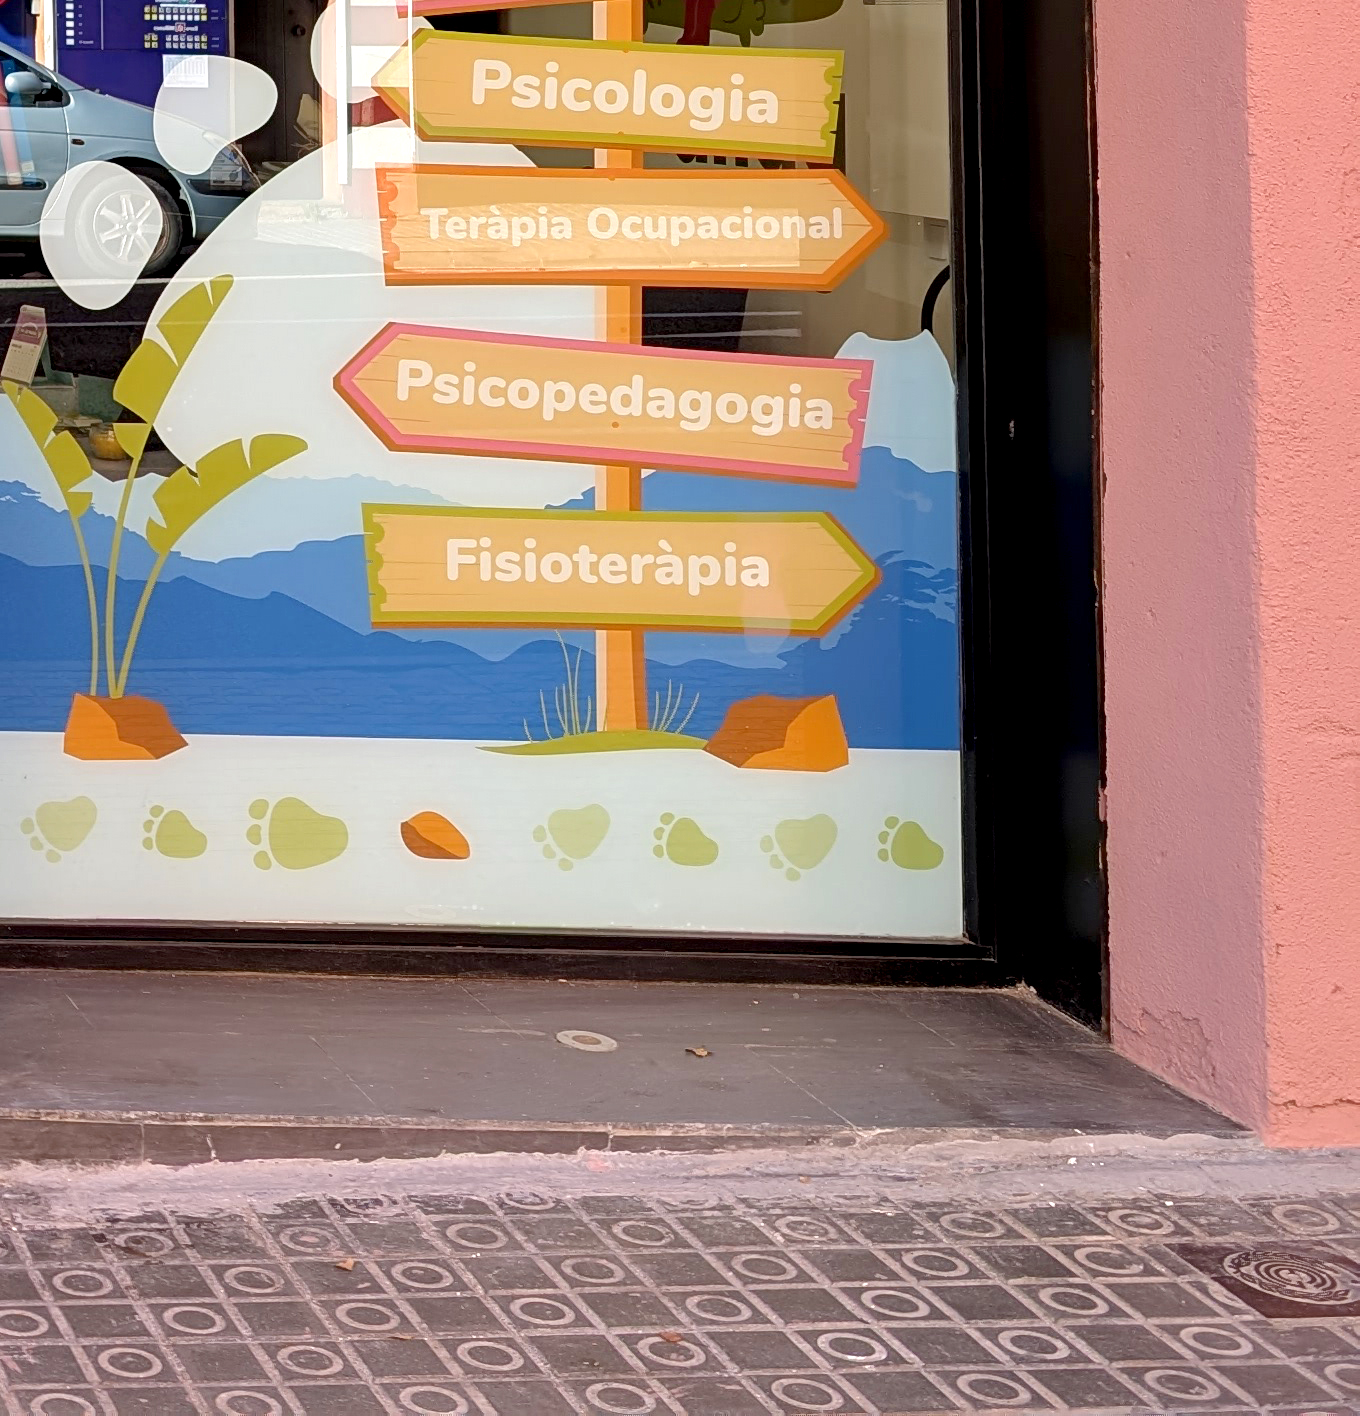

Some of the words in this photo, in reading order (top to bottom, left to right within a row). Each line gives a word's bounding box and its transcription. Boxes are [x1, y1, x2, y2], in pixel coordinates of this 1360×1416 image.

[472, 59, 780, 131] Psicologia
[420, 205, 573, 246] Teràpia
[587, 205, 843, 246] Ocupacional
[396, 359, 834, 436] Psicopedagogia
[446, 537, 771, 595] Fisioteràpia
